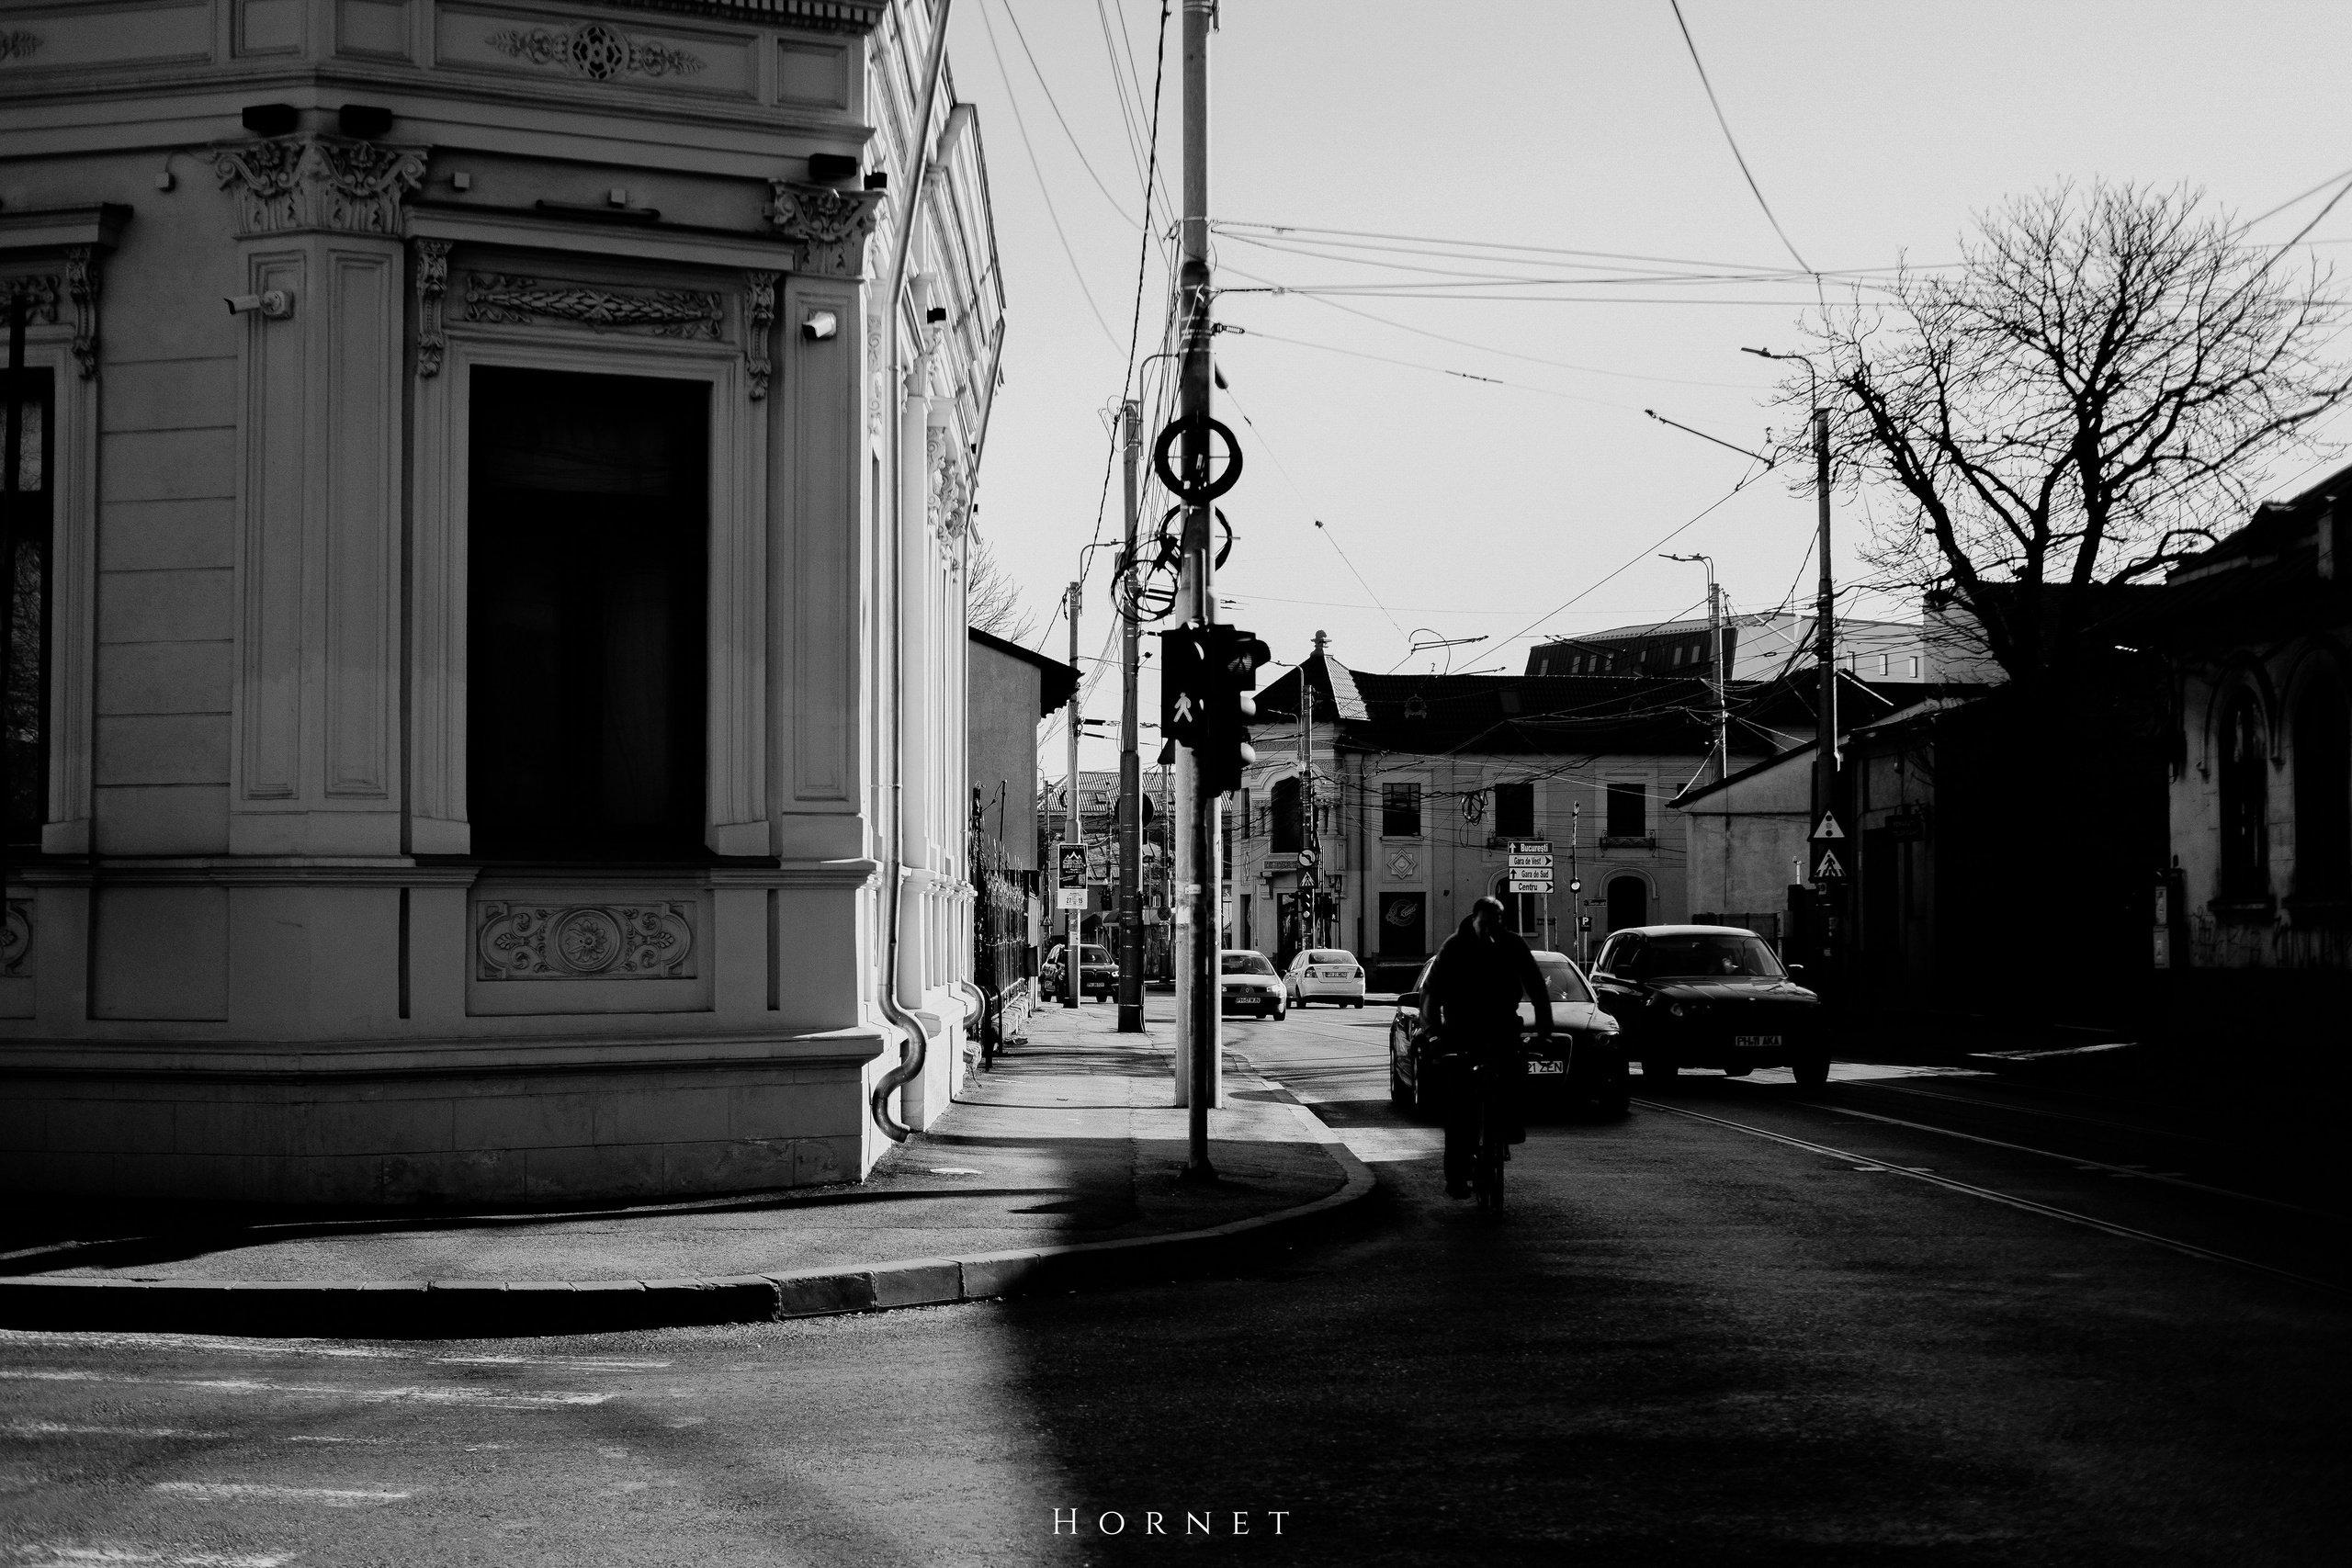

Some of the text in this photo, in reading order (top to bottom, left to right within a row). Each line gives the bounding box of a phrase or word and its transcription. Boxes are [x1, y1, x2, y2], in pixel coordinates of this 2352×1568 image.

[1519, 883, 1537, 891] Centru
[1582, 917, 1589, 925] P
[1540, 1062, 1562, 1072] ZEN
